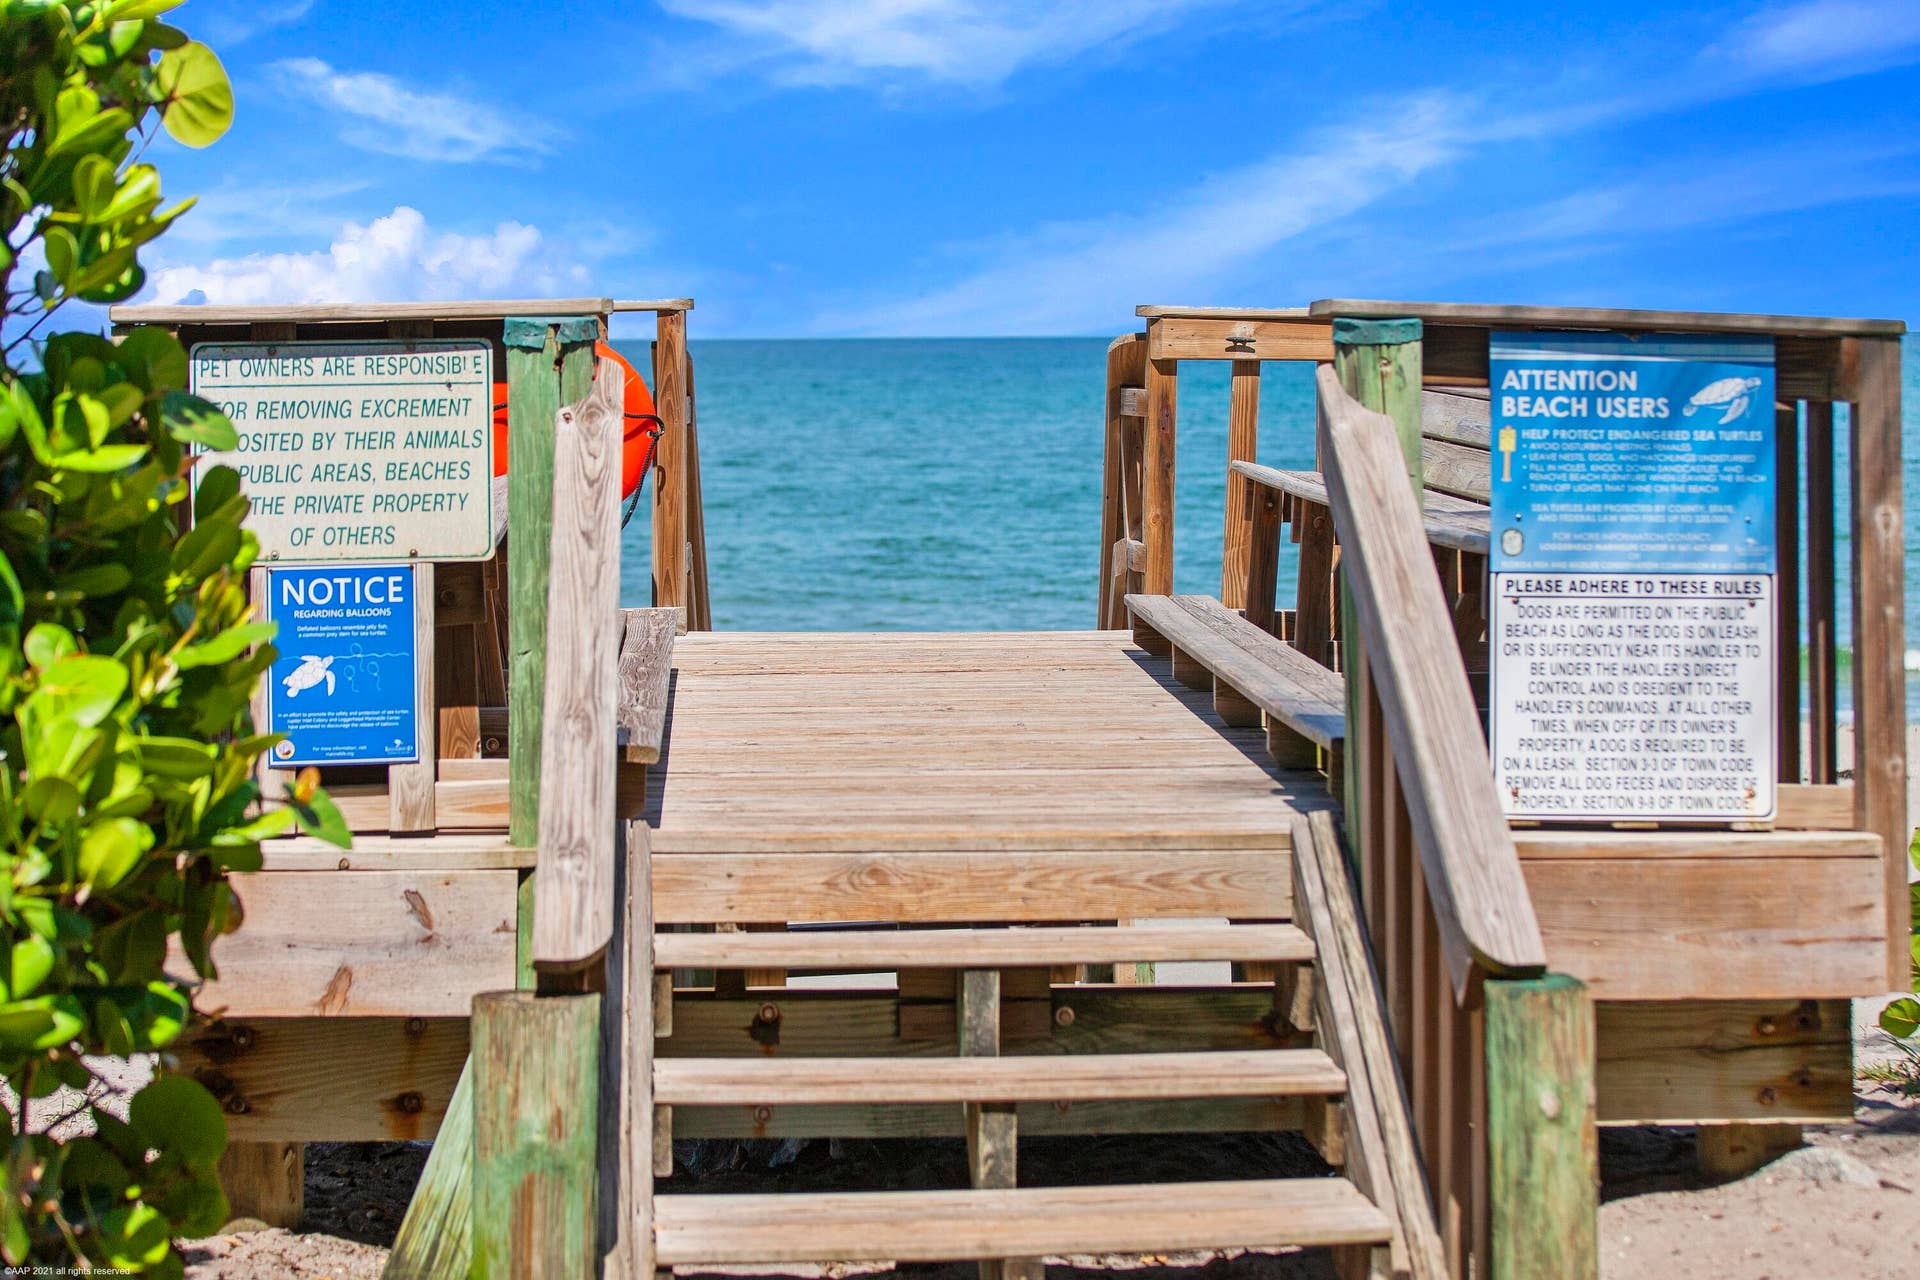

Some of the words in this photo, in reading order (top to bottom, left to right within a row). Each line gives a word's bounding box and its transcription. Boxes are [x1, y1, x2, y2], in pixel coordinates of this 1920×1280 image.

[200, 359, 231, 378] PET
[240, 358, 314, 377] OWNERS
[323, 357, 355, 376] ARE
[1502, 370, 1637, 391] ATTENTION
[211, 402, 248, 420] OR
[256, 400, 352, 419] REMOVING
[361, 398, 472, 418] EXCREMENT
[1502, 396, 1589, 417] BEACH
[1597, 398, 1669, 418] USERS
[313, 432, 336, 450] BY
[345, 431, 395, 450] THEIR
[404, 429, 482, 449] ANIMALS
[1522, 429, 1549, 439] HELP
[1553, 429, 1604, 440] PROTECT
[1608, 430, 1690, 441] ENDANGERED
[1693, 430, 1715, 441] SEA
[1719, 430, 1763, 442] TURTLES
[238, 464, 302, 483] PUBLIC
[311, 463, 376, 485] AREAS,
[385, 461, 470, 481] BEACHES
[250, 496, 284, 515] THE
[294, 494, 363, 514] PRIVATE
[372, 492, 468, 513] PROPERTY
[290, 527, 315, 546] OF
[323, 526, 395, 545] OTHERS
[283, 576, 403, 605] NOTICE
[1506, 580, 1562, 594] PLEASE
[1569, 580, 1628, 594] ADHERE
[1637, 580, 1653, 594] TO
[1660, 580, 1707, 594] THESE
[1714, 580, 1761, 594] RULES
[294, 609, 343, 619] REGARDING
[346, 608, 391, 618] BALLOONS
[1518, 605, 1551, 620] DOGS
[1557, 605, 1579, 620] ARE
[1584, 605, 1651, 620] PERMITTED
[1655, 605, 1672, 620] ON
[1677, 605, 1698, 620] THE
[1704, 605, 1745, 620] PUBLIC
[1505, 625, 1547, 638] BEACH
[1552, 625, 1565, 638] AS
[1571, 625, 1603, 638] LONG
[1607, 625, 1622, 638] AS
[1628, 625, 1648, 638] THE
[1654, 625, 1679, 638] DOG
[1684, 625, 1694, 638] IS
[1699, 625, 1715, 638] ON
[1719, 625, 1758, 638] LEASH
[1503, 643, 1520, 657] OR
[1525, 643, 1534, 657] IS
[1540, 643, 1622, 657] SUFFICIENTLY
[1626, 643, 1657, 657] NEAR
[1662, 643, 1680, 657] ITS
[1685, 643, 1739, 657] HANDLER
[1744, 643, 1760, 657] TO
[1531, 662, 1544, 677] BE
[1551, 662, 1590, 677] UNDER
[1596, 662, 1617, 677] THE
[1622, 662, 1689, 677] HANDLER'S
[1694, 662, 1737, 677] DIRECT
[1528, 682, 1584, 696] CONTROL
[1590, 682, 1614, 696] AND
[1618, 682, 1628, 696] IS
[1632, 682, 1692, 696] OBEDIENT
[1697, 682, 1712, 696] TO
[1717, 682, 1739, 696] THE
[1515, 701, 1584, 715] HANDLER'S
[1668, 701, 1682, 715] AT
[1687, 701, 1706, 715] ALL
[1712, 701, 1751, 715] OTHER
[1574, 720, 1608, 734] WHEN
[1613, 720, 1635, 734] OFF
[1640, 720, 1655, 734] OF
[1659, 720, 1676, 734] ITS
[1682, 720, 1736, 734] OWNER'S
[1589, 738, 1596, 753] A
[1600, 738, 1626, 753] DOG
[1630, 738, 1640, 753] IS
[1645, 738, 1705, 753] REQUIRED
[1711, 738, 1725, 753] TO
[1730, 738, 1745, 753] BE
[1504, 757, 1519, 772] ON
[1525, 757, 1531, 772] A
[1585, 757, 1637, 772] SECTION
[1662, 757, 1676, 772] OF
[1682, 757, 1715, 772] TOWN
[1506, 776, 1555, 790] REMOVE
[1560, 776, 1581, 790] ALL
[1586, 776, 1611, 790] DOG
[1616, 776, 1655, 790] FECES
[1659, 776, 1682, 790] AND
[1686, 776, 1737, 790] DISPOSE
[1742, 776, 1757, 790] OF
[1583, 795, 1634, 810] SECTION
[1659, 795, 1673, 810] OF
[1679, 795, 1712, 810] TOWN
